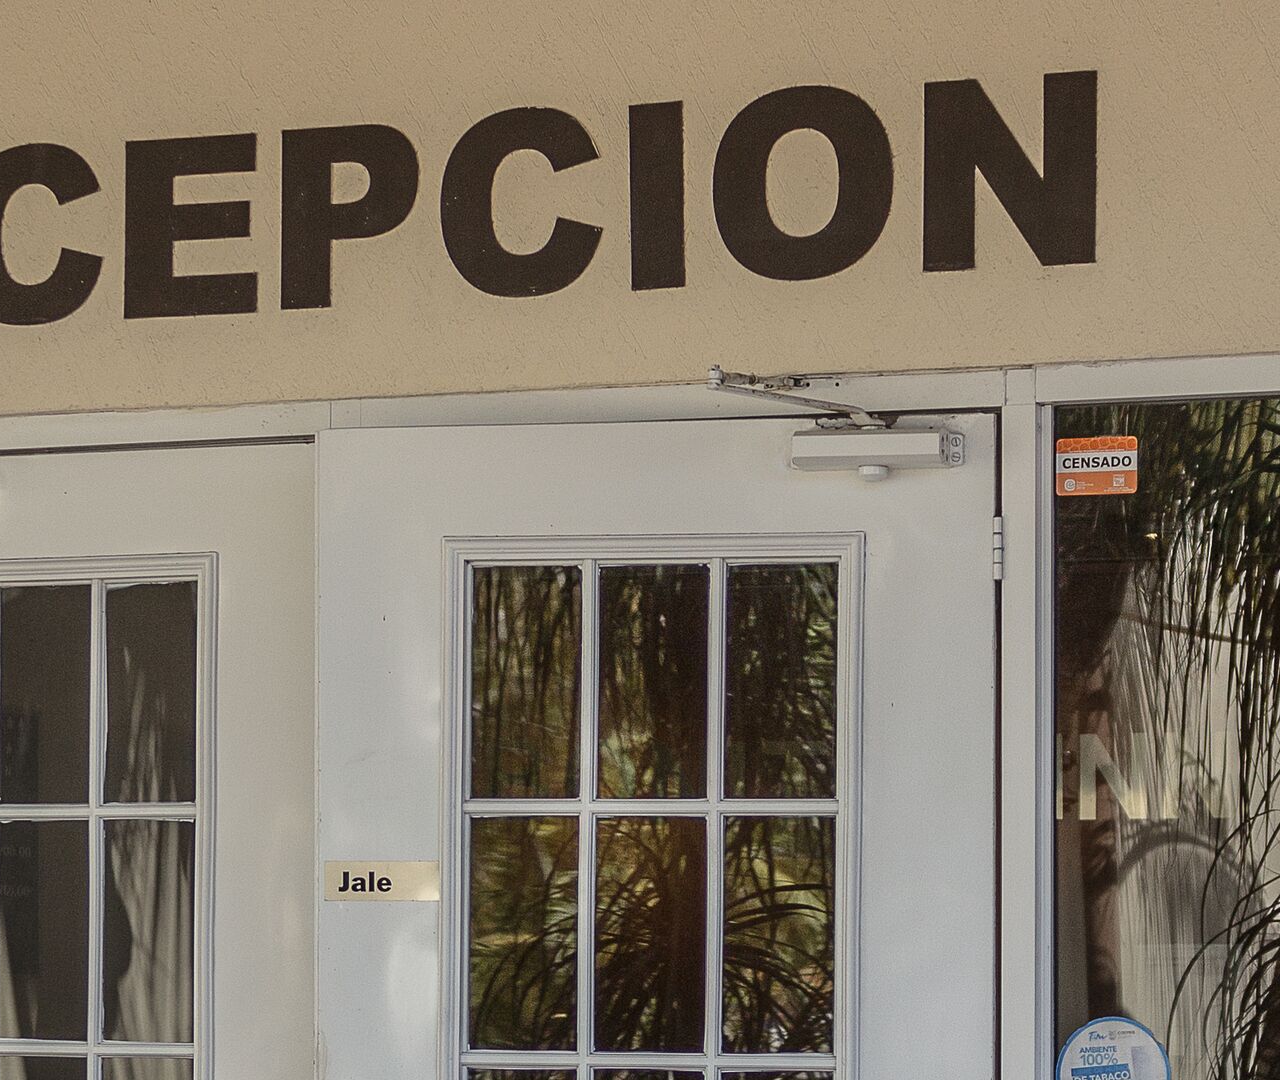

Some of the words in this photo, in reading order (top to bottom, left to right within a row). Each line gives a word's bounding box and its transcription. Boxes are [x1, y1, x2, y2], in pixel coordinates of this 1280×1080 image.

[1062, 456, 1131, 468] CENSADO
[338, 871, 392, 892] Jale
[1079, 1045, 1118, 1054] AMBIENTE
[1080, 1053, 1118, 1066] 100%
